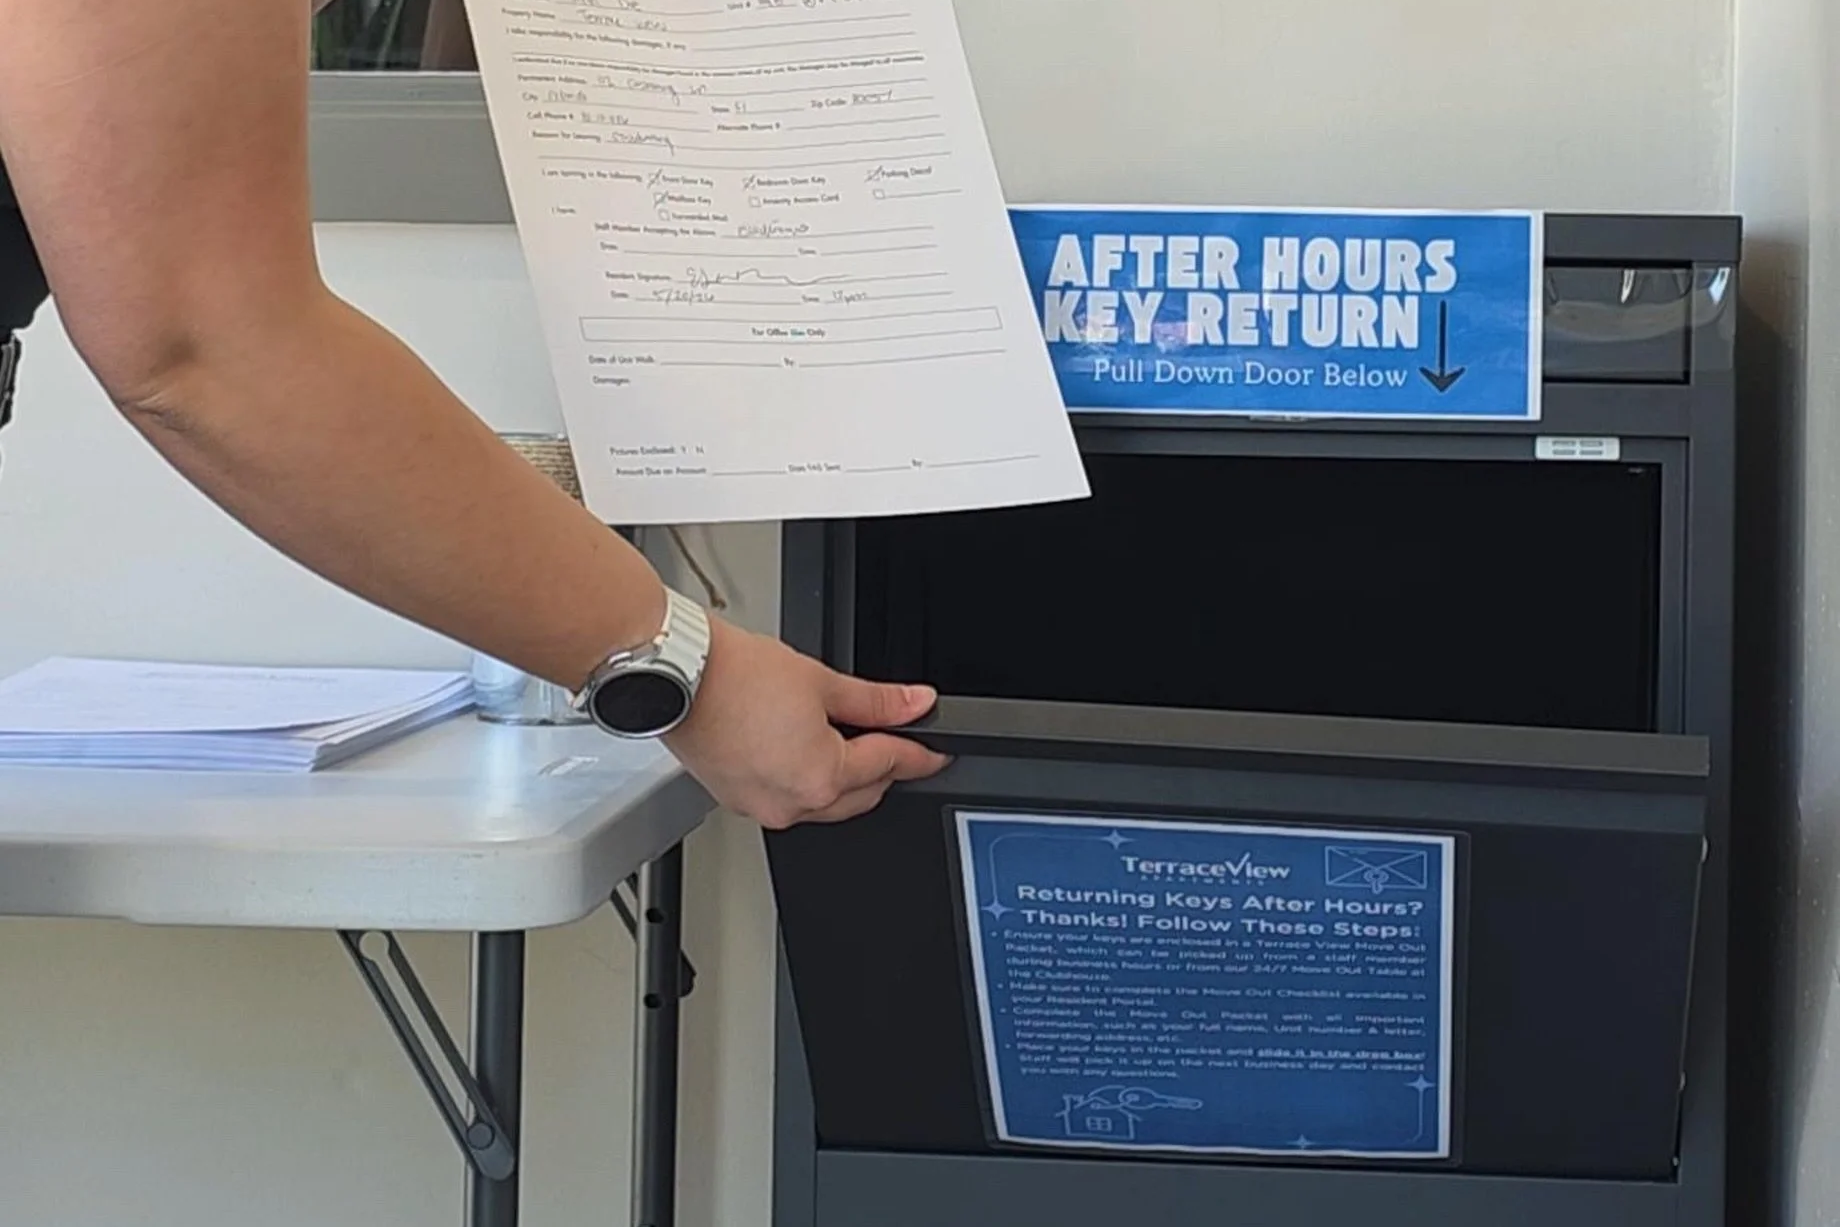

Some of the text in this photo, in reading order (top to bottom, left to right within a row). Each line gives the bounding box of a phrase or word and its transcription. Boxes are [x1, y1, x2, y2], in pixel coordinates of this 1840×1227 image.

[1048, 234, 1457, 294] AFTER HOURS
[1044, 290, 1419, 350] KEY RETURN
[1093, 358, 1408, 390] Pull Down Door Below
[1120, 852, 1290, 879] TerraceView
[1017, 885, 1424, 916] Returning Keys After Hours?
[1020, 909, 1422, 938] Thanks! Follow These Steps:
